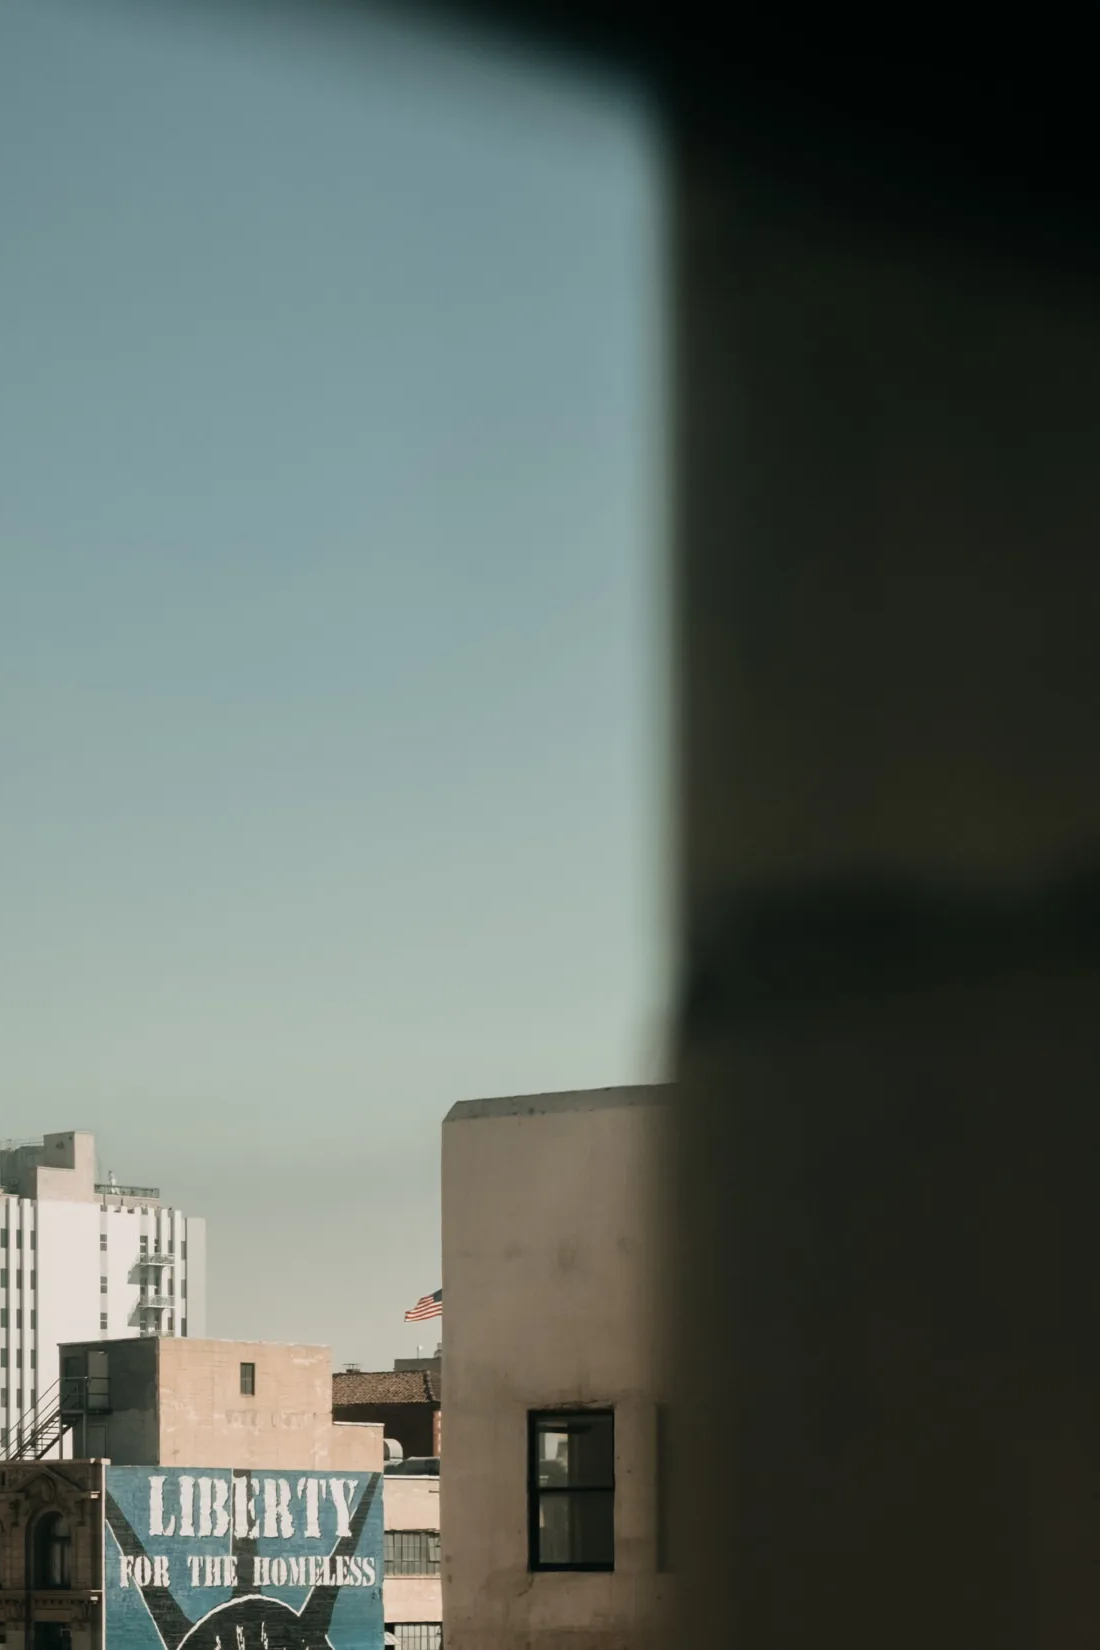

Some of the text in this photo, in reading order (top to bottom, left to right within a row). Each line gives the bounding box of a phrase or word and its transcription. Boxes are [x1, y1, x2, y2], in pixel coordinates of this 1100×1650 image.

[148, 1475, 359, 1539] LIBERTY
[118, 1555, 376, 1588] FOR THE HOMELESS
